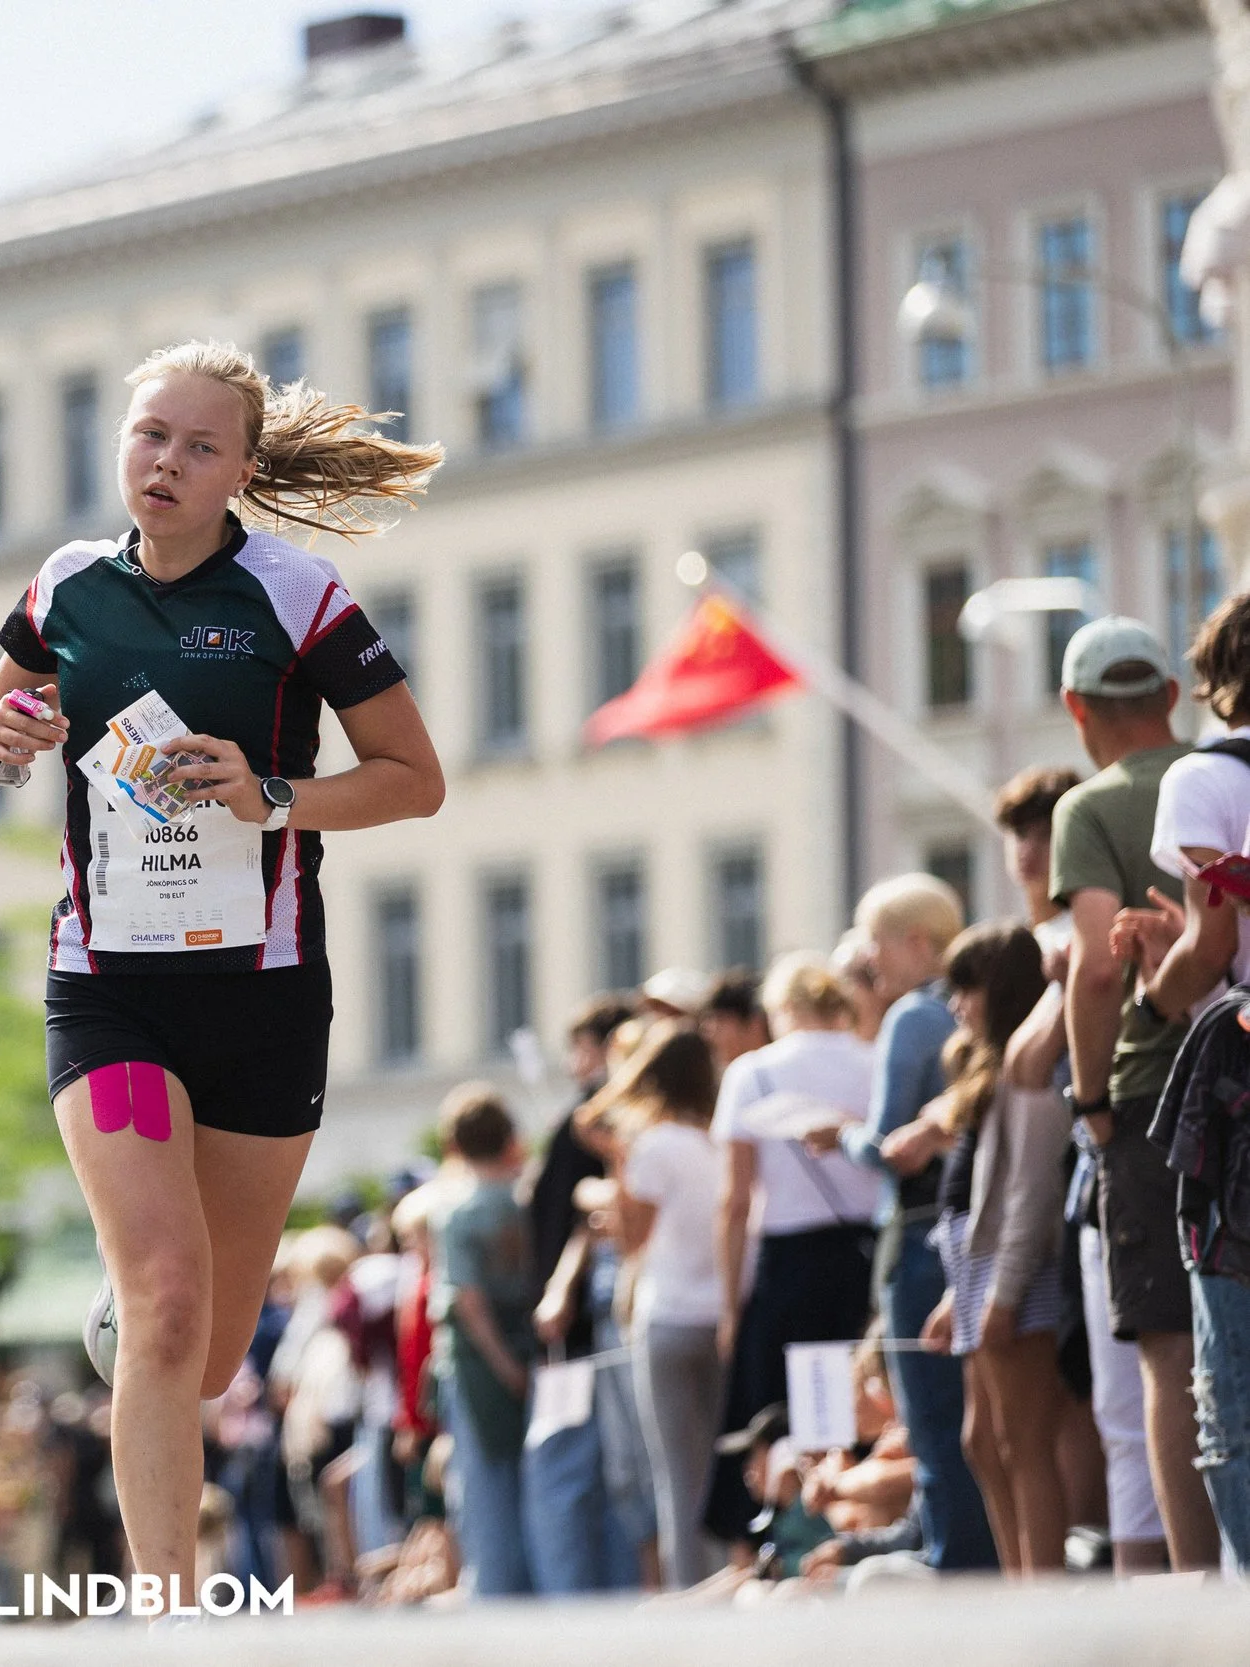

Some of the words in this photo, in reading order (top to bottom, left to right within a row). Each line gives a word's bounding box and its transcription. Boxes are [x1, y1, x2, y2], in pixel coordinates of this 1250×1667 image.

[121, 717, 144, 745] MERS
[141, 853, 202, 872] HILMA
[146, 879, 187, 887] JÖNKÖPINGS
[172, 891, 185, 899] ELIT
[131, 934, 175, 942] CHALMERS
